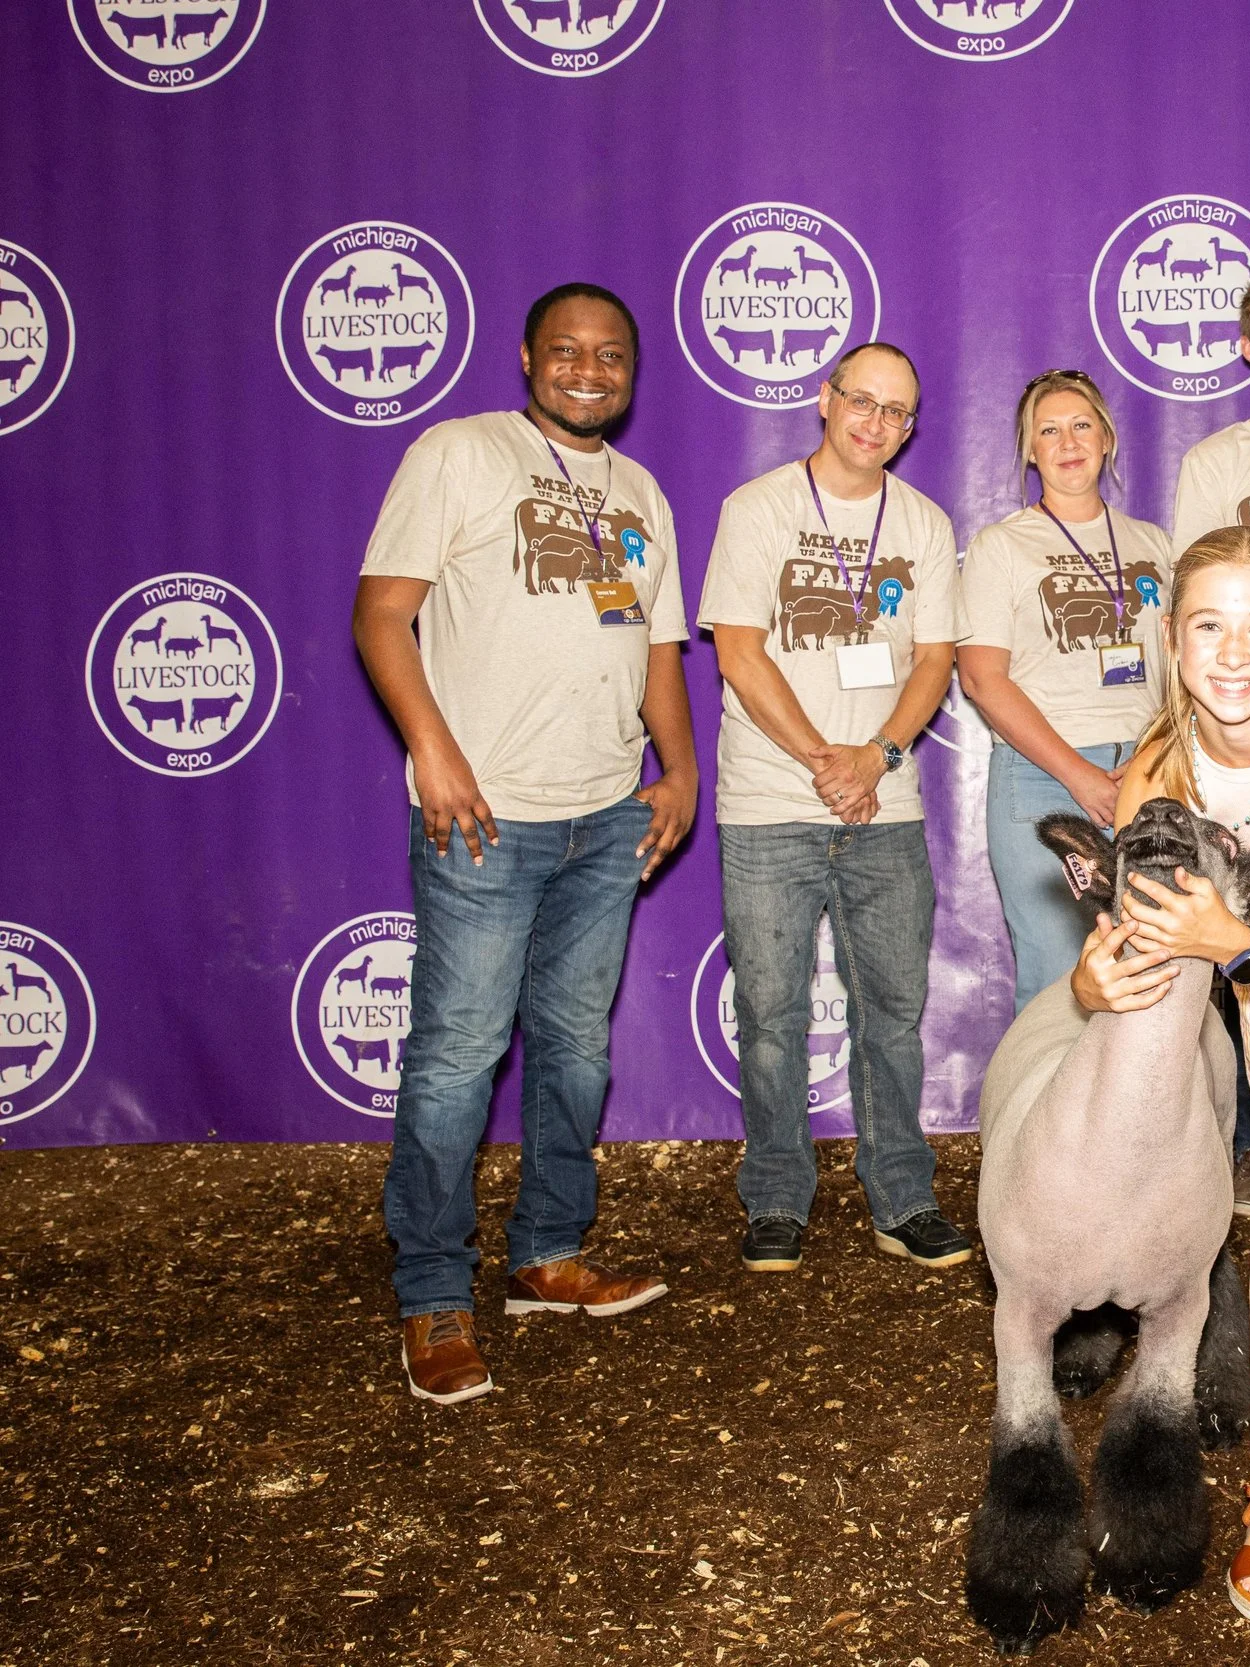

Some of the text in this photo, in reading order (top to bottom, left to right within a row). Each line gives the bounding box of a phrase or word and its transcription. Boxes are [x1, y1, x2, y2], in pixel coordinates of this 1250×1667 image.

[957, 34, 1005, 56] expo
[550, 50, 598, 72] expo
[147, 66, 195, 88] expo
[731, 206, 822, 236] michigan
[1148, 200, 1236, 228] michigan
[332, 226, 418, 255] michigan
[704, 295, 849, 322] LIVESTOCK
[1121, 287, 1243, 313] LIVESTOC
[305, 310, 444, 340] LIVESTOCK
[754, 381, 803, 404] expo
[1172, 375, 1220, 395] expo
[354, 398, 401, 421] expo
[530, 474, 603, 502] MEAT
[536, 490, 601, 509] US AT THE
[532, 502, 616, 541] FAIR
[628, 536, 640, 547] m
[798, 530, 869, 554] MEAT
[799, 548, 816, 557] US
[819, 551, 835, 559] AT
[1045, 551, 1112, 566] MEAT
[142, 577, 227, 606] michigan
[885, 586, 898, 597] m
[1142, 582, 1153, 590] m
[116, 662, 252, 690] LIVESTOCK
[166, 749, 212, 771] expo
[1068, 854, 1088, 885] F6179
[323, 1004, 411, 1028] LIVEST
